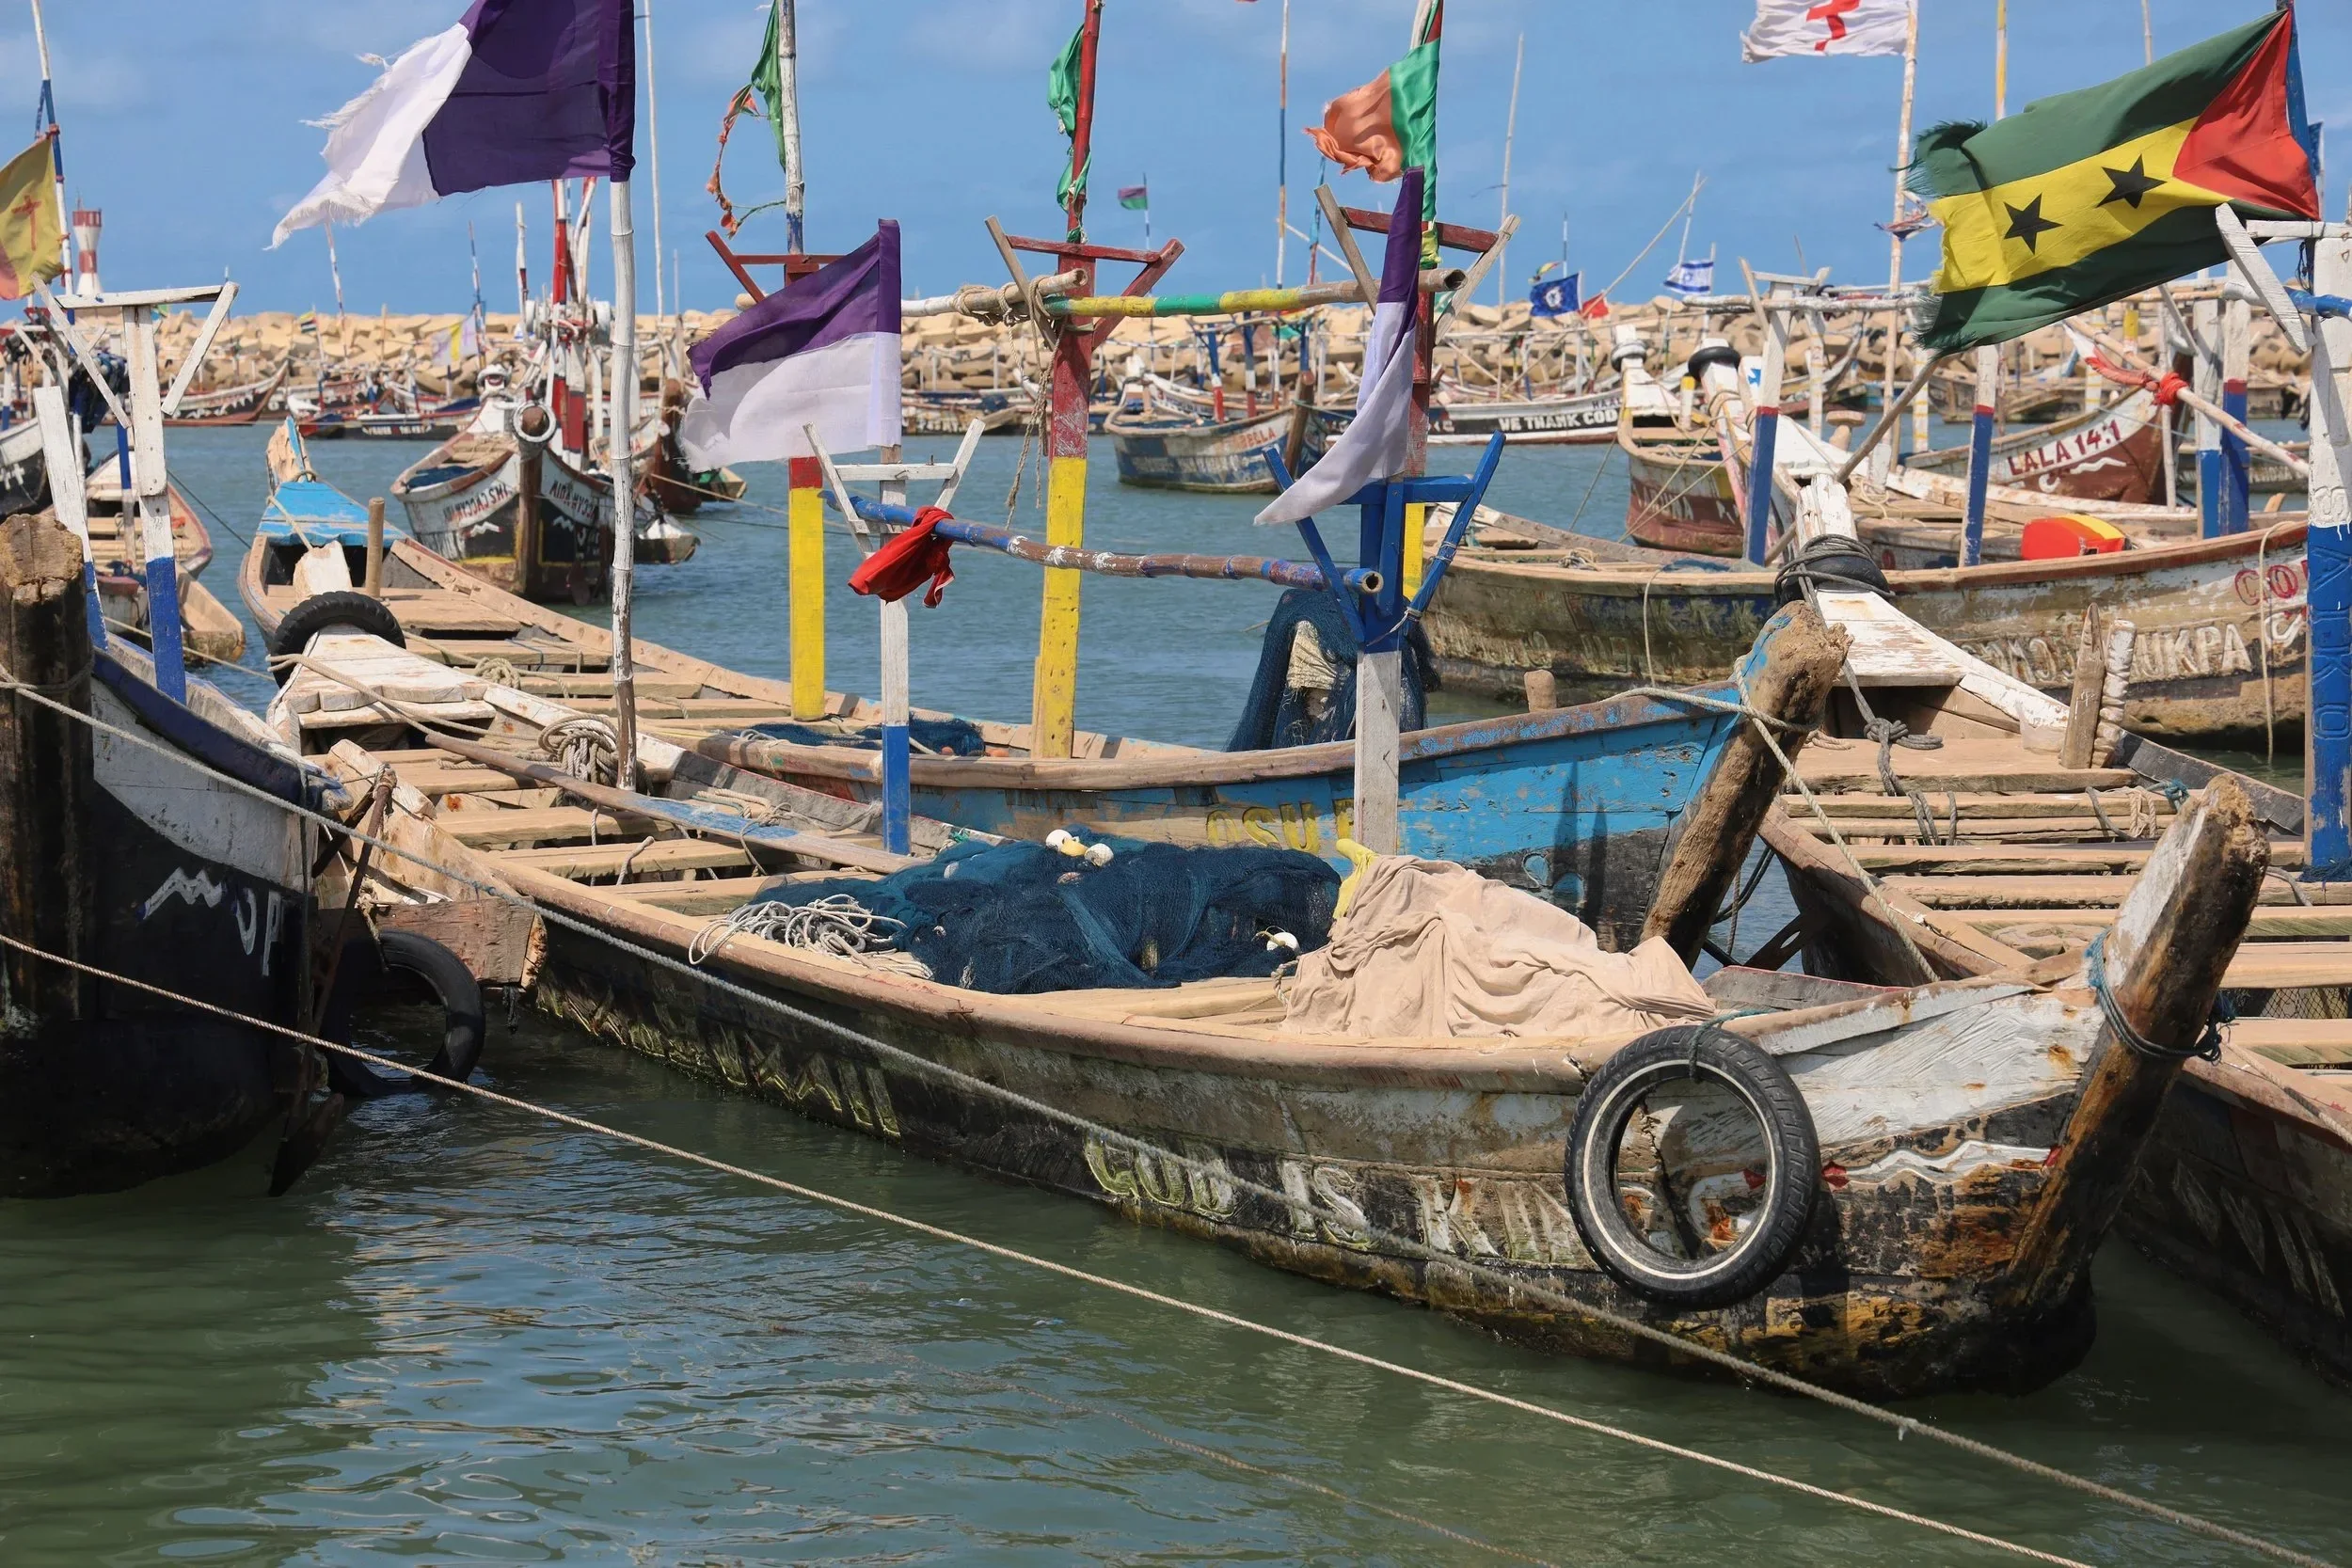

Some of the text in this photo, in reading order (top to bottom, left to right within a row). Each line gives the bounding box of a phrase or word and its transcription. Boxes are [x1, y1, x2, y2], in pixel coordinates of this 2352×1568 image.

[1524, 413, 1581, 430] THANK
[2007, 440, 2072, 476] LALA
[2234, 559, 2308, 607] CO
